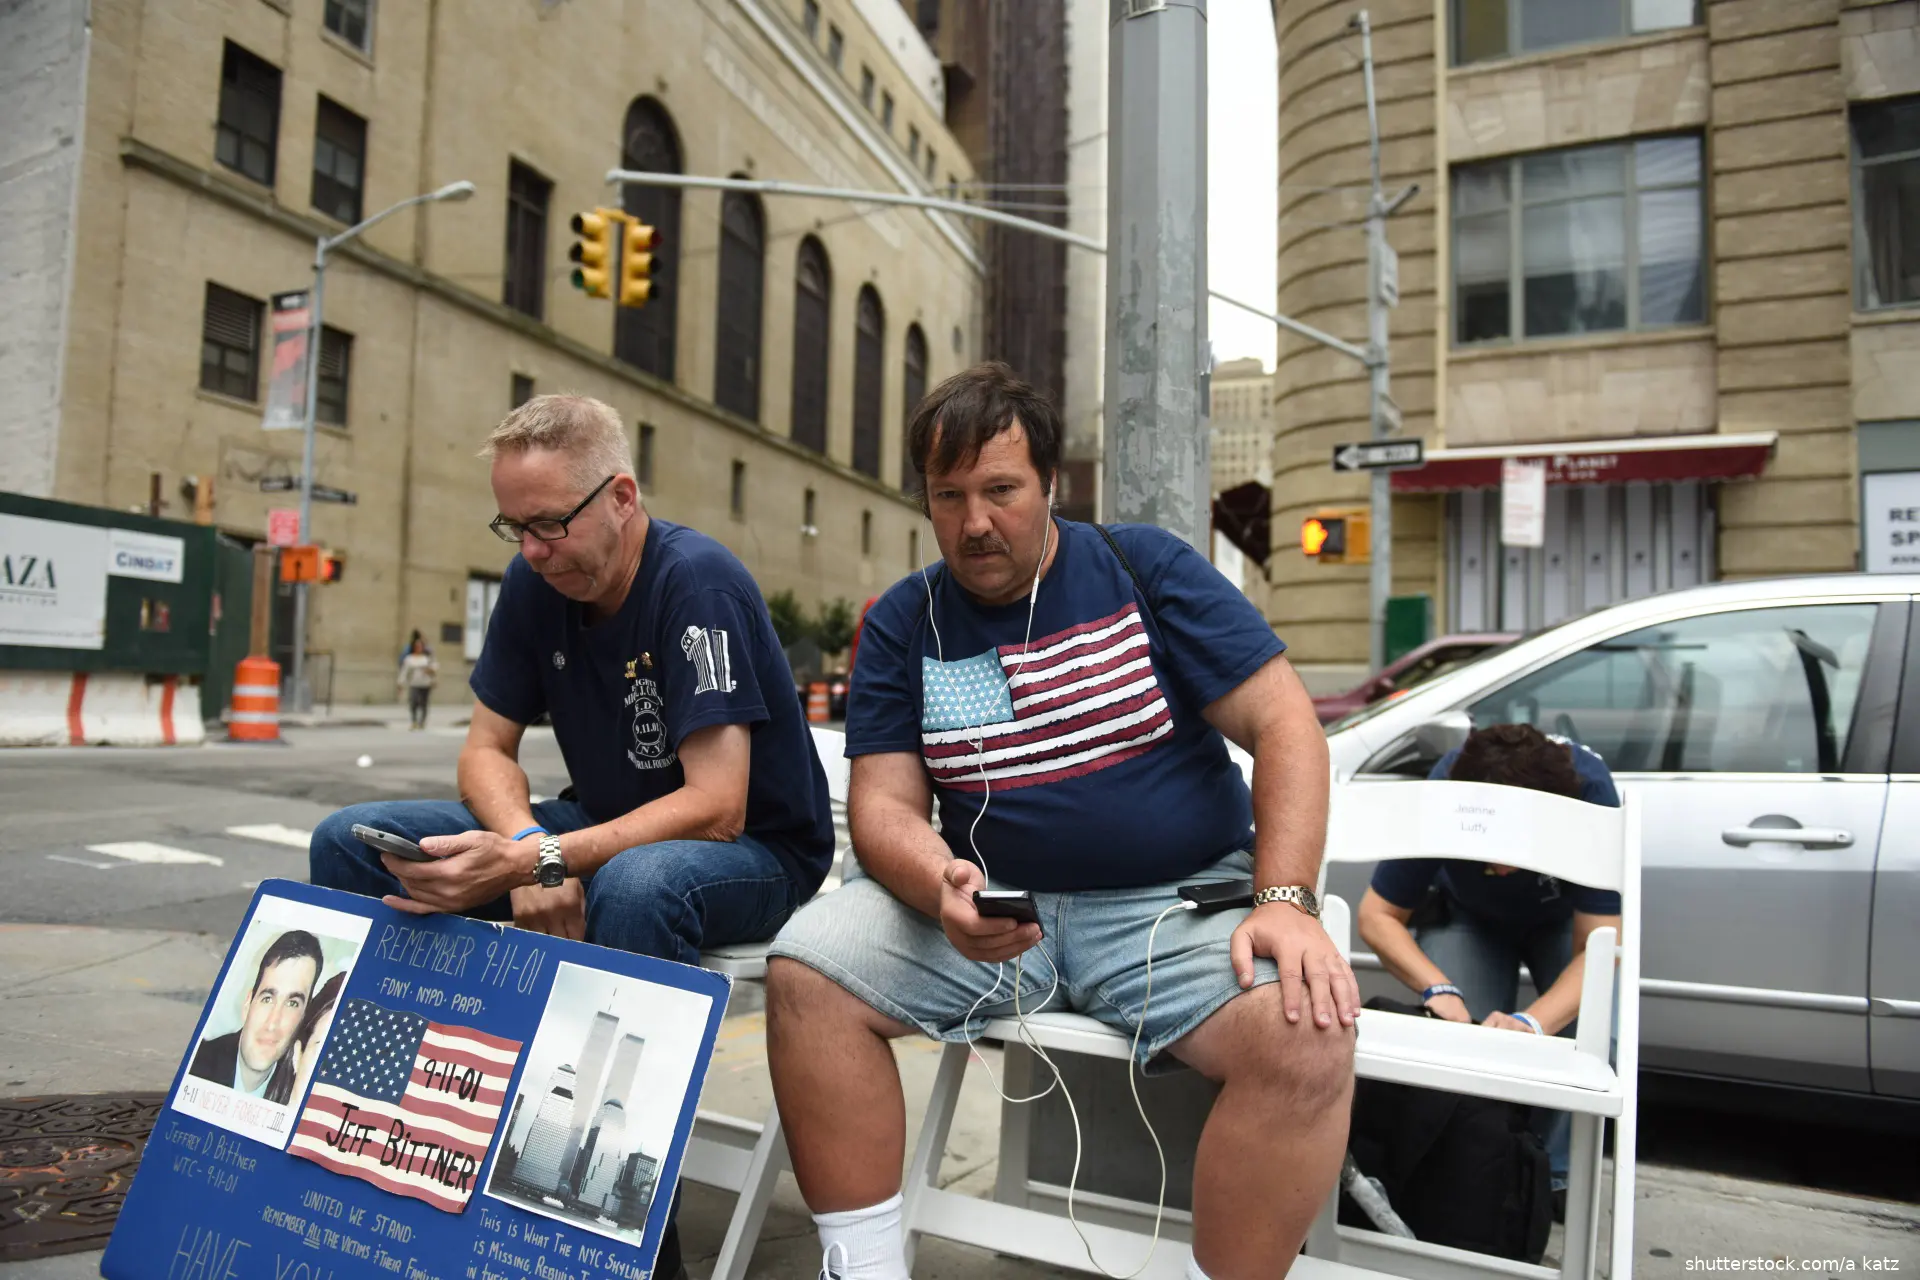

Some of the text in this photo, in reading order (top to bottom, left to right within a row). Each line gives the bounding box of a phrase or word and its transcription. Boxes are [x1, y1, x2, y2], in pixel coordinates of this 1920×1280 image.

[635, 722, 660, 734] 9.11.01
[375, 924, 546, 995] REMEMBER 9-11-01
[424, 1059, 483, 1102] 9-11-01
[183, 1085, 199, 1103] 9-11
[349, 1205, 367, 1227] WE
[323, 1228, 340, 1249] THE
[578, 1244, 604, 1268] NYC
